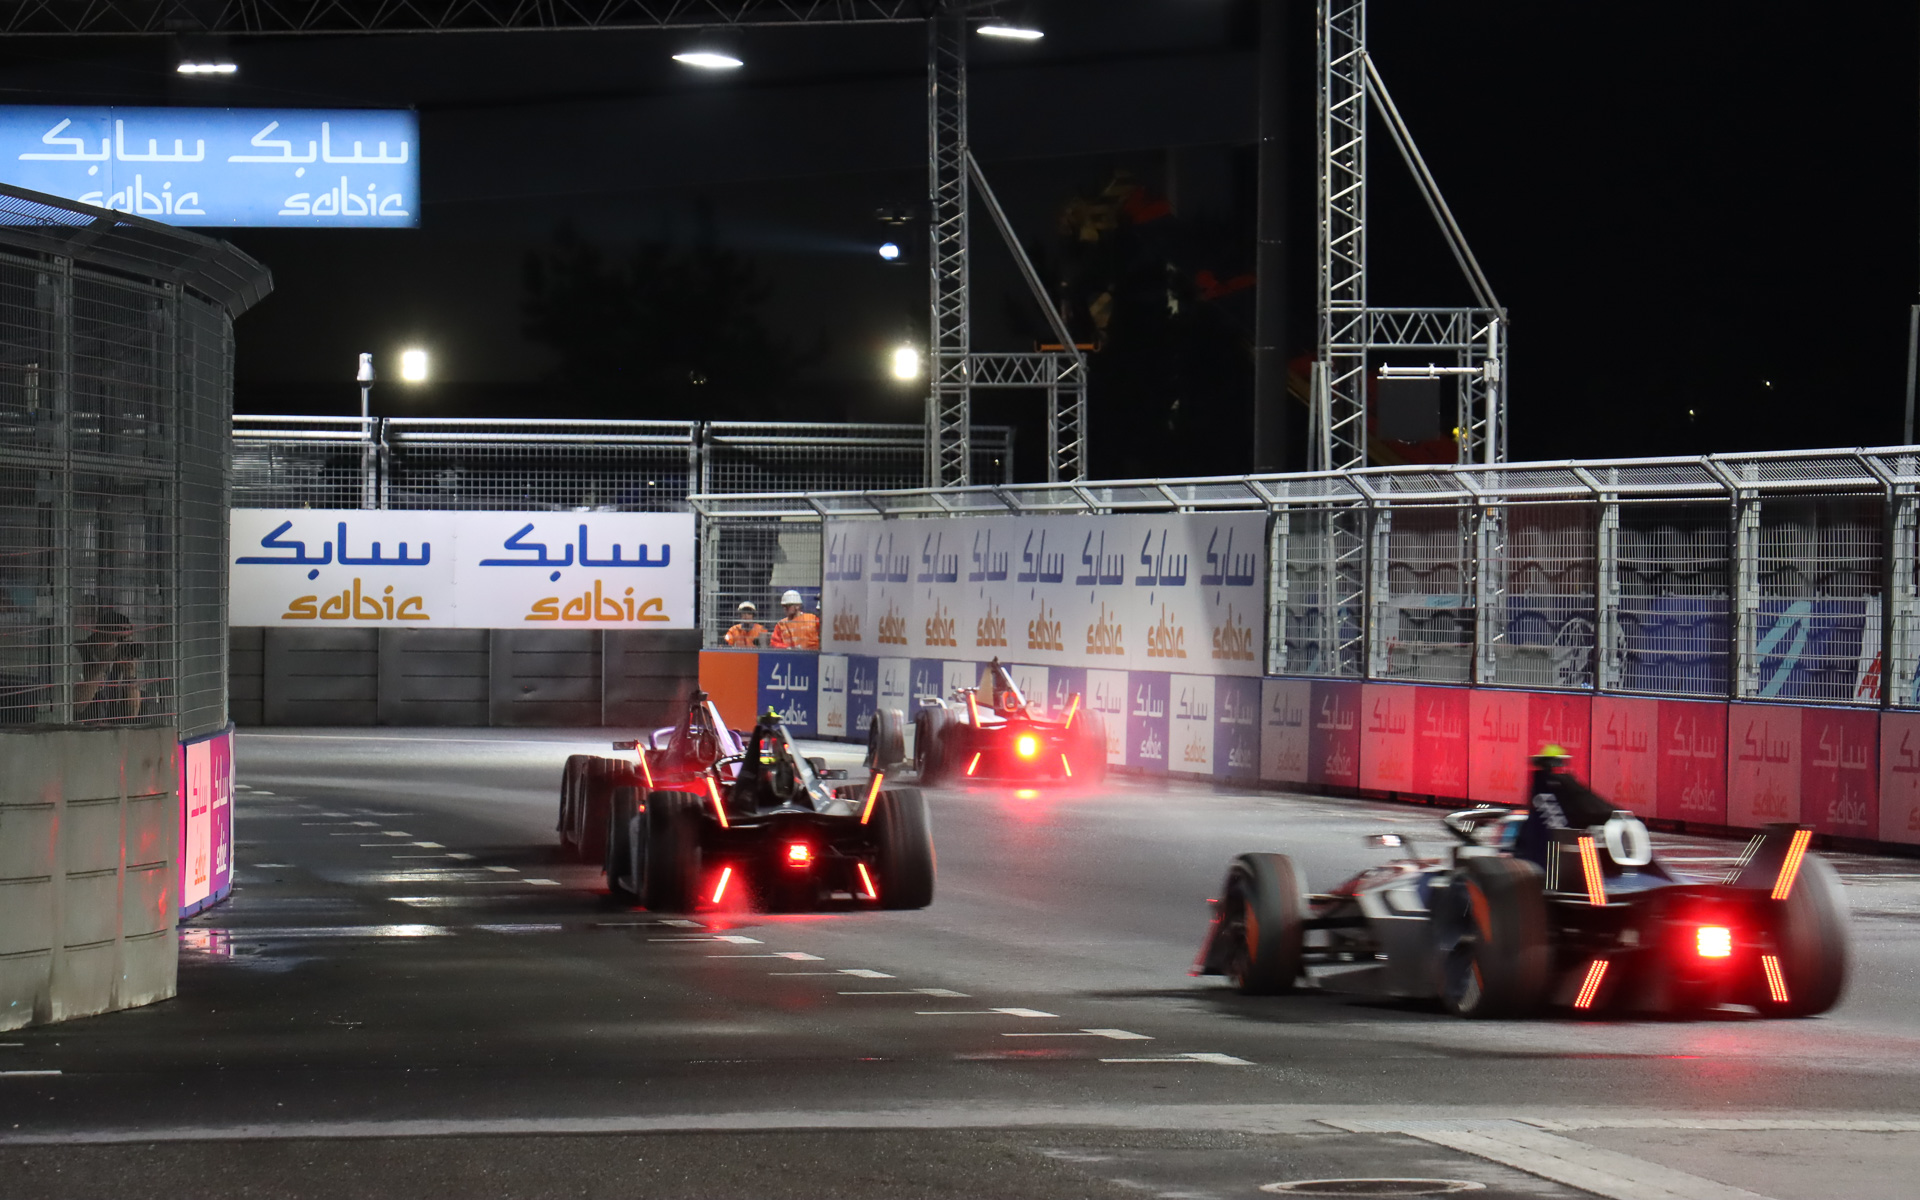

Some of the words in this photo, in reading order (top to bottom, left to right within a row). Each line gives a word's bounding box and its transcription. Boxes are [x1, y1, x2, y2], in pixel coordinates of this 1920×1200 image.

[18, 118, 205, 176] سابك
[228, 121, 409, 178] سابك
[278, 176, 409, 216] sabic
[235, 520, 430, 580] سابك
[479, 522, 671, 582] سابك
[826, 533, 862, 597] سابك
[870, 532, 909, 598] سابك
[917, 532, 958, 599] سابك
[969, 528, 1008, 599] سابك
[1017, 528, 1064, 601] سابك
[1076, 530, 1124, 604] سابك
[1135, 529, 1187, 605] سابك
[1200, 526, 1255, 606] سابك
[281, 578, 430, 620] sabic
[524, 580, 671, 622] sabic
[766, 663, 809, 699] سابك
